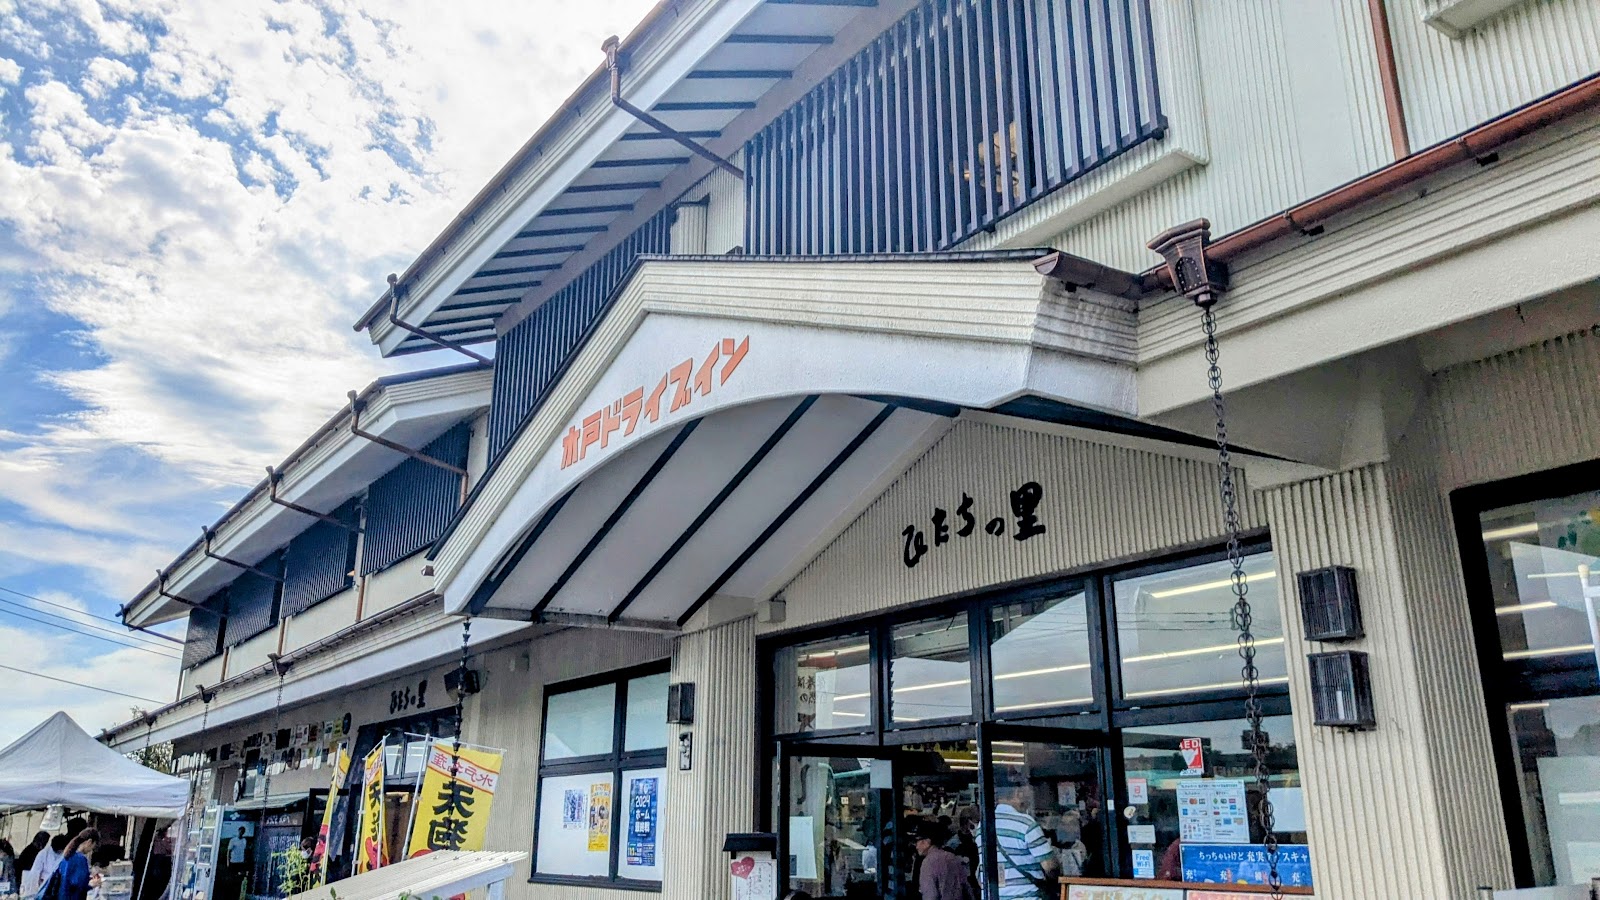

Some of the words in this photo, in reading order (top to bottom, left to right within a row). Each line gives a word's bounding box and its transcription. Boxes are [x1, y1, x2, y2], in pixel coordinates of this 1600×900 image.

[561, 335, 749, 470] 水戸ドライブイン
[902, 482, 1046, 568] ひたちの里
[636, 795, 650, 807] 2024
[636, 809, 650, 820] ホーム
[1136, 853, 1149, 861] Free
